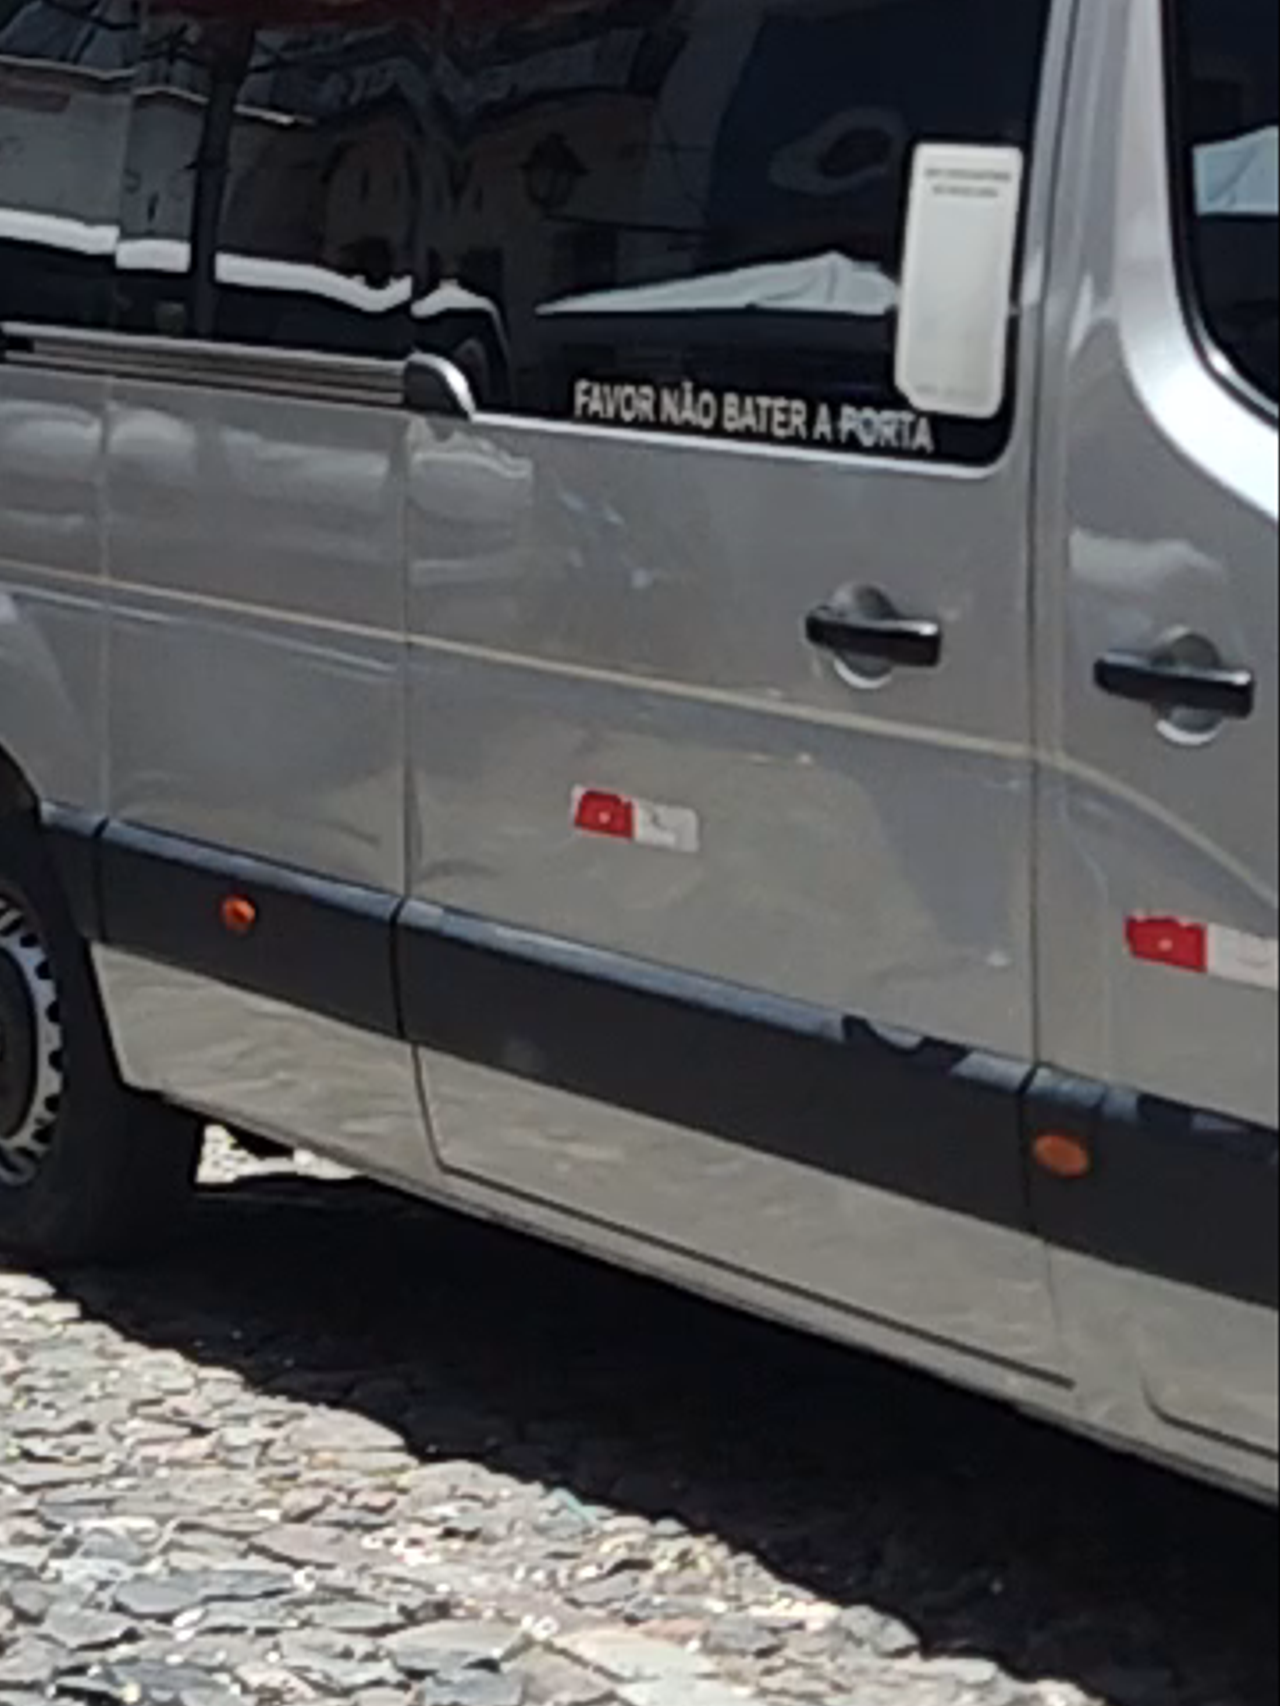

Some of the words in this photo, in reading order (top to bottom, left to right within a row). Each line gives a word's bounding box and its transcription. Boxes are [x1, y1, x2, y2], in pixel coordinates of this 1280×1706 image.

[573, 379, 656, 422] FAVOR
[659, 380, 718, 430] NÃO
[722, 392, 807, 440] BATER
[812, 402, 832, 441] A
[839, 406, 934, 454] PORTA
